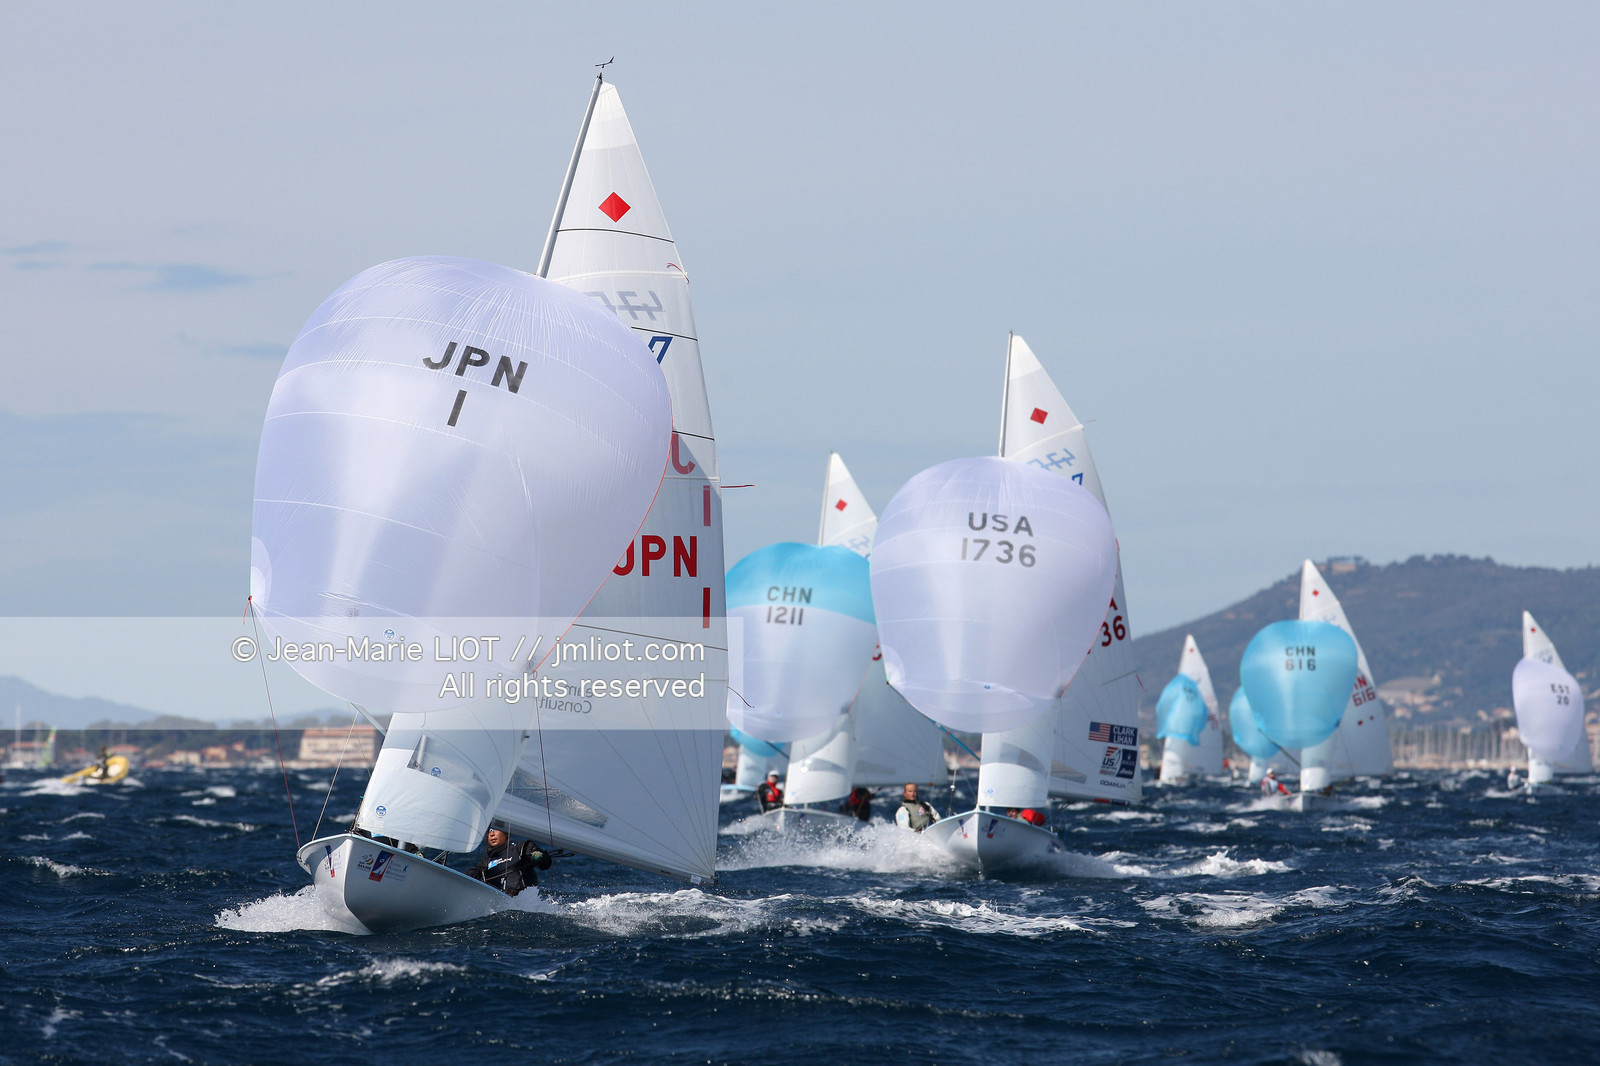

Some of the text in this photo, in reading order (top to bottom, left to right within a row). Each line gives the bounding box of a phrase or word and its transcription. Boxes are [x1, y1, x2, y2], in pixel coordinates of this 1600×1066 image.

[422, 341, 528, 394] JPN
[968, 512, 1034, 537] USA
[613, 535, 697, 577] JPN
[961, 538, 1036, 568] 1736
[767, 586, 812, 604] CHN
[767, 606, 804, 626] 1211
[1101, 615, 1126, 647] 36
[1285, 646, 1316, 657] CHN
[1285, 659, 1316, 671] 616
[1352, 687, 1376, 707] 616
[1113, 726, 1135, 736] CLARK
[1113, 735, 1133, 745] LIHAN
